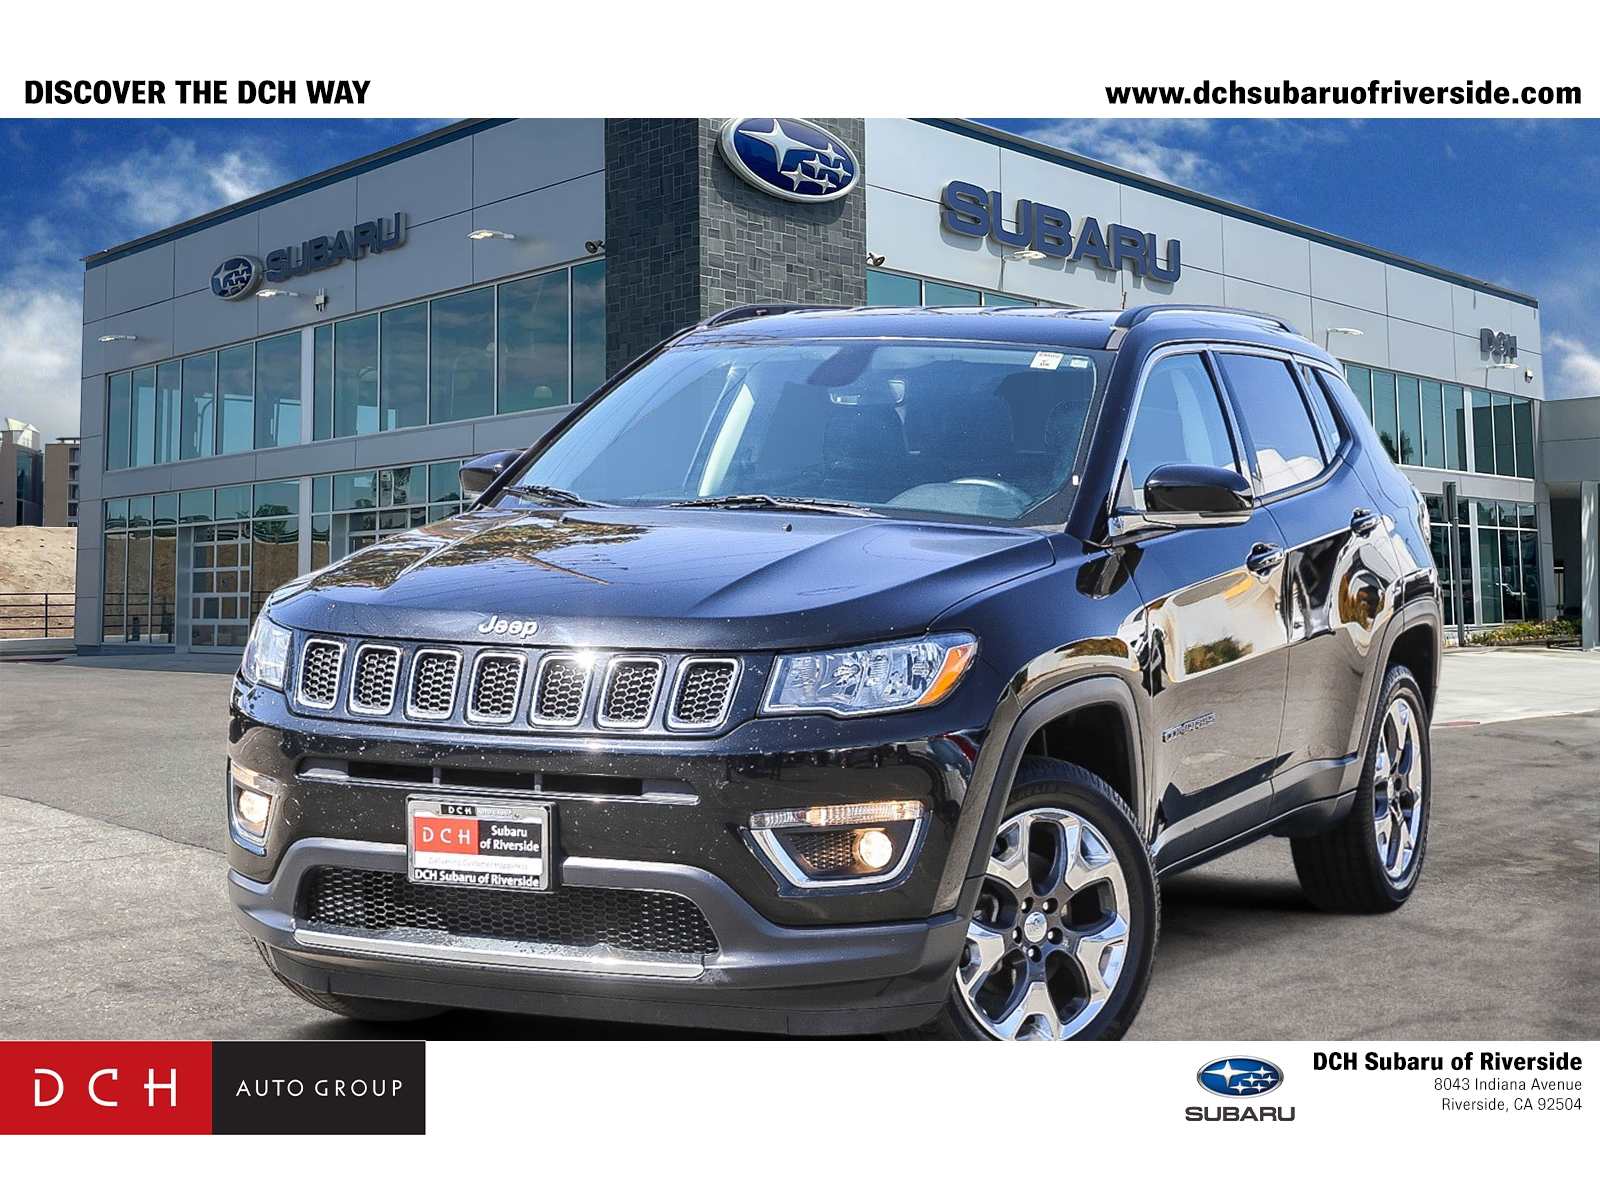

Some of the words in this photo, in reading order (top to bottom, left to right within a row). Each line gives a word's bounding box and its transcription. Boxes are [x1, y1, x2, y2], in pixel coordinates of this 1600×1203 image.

[943, 180, 1181, 283] SUBARU
[266, 212, 406, 283] SUBARU
[479, 614, 539, 640] Jeep
[422, 826, 471, 845] DCH
[491, 825, 528, 837] Subaru
[480, 839, 491, 849] of
[493, 840, 540, 852] Riverside
[414, 869, 437, 880] DCH
[440, 870, 476, 882] Subaru
[478, 873, 490, 883] of
[491, 875, 540, 887] Riverside
